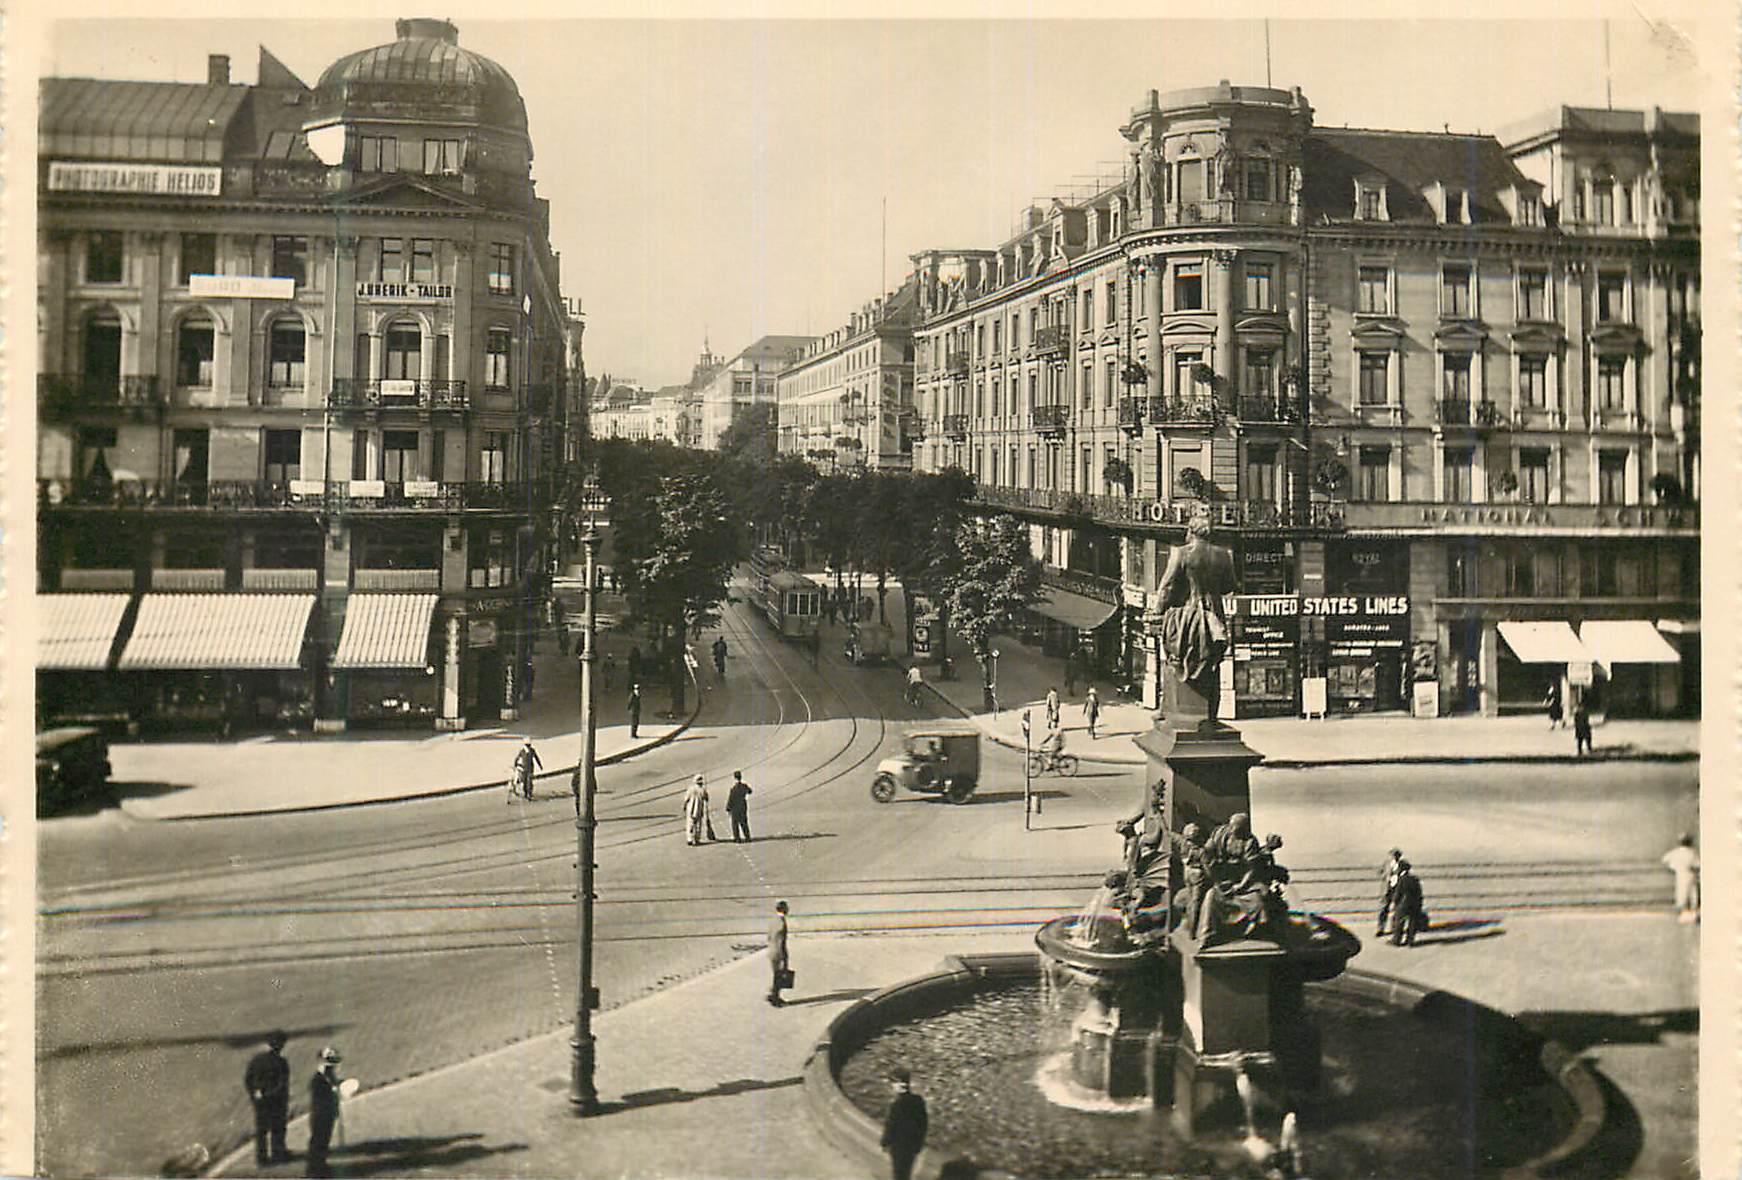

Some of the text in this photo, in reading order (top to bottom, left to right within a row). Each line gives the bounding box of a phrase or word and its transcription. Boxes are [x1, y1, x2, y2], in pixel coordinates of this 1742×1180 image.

[167, 171, 216, 191] HELIOS
[418, 285, 452, 298] TAILOR
[1421, 507, 1556, 526] NATIONAL
[1250, 598, 1298, 616] UNITED
[1303, 597, 1358, 615] STATES
[1365, 596, 1408, 615] LINES
